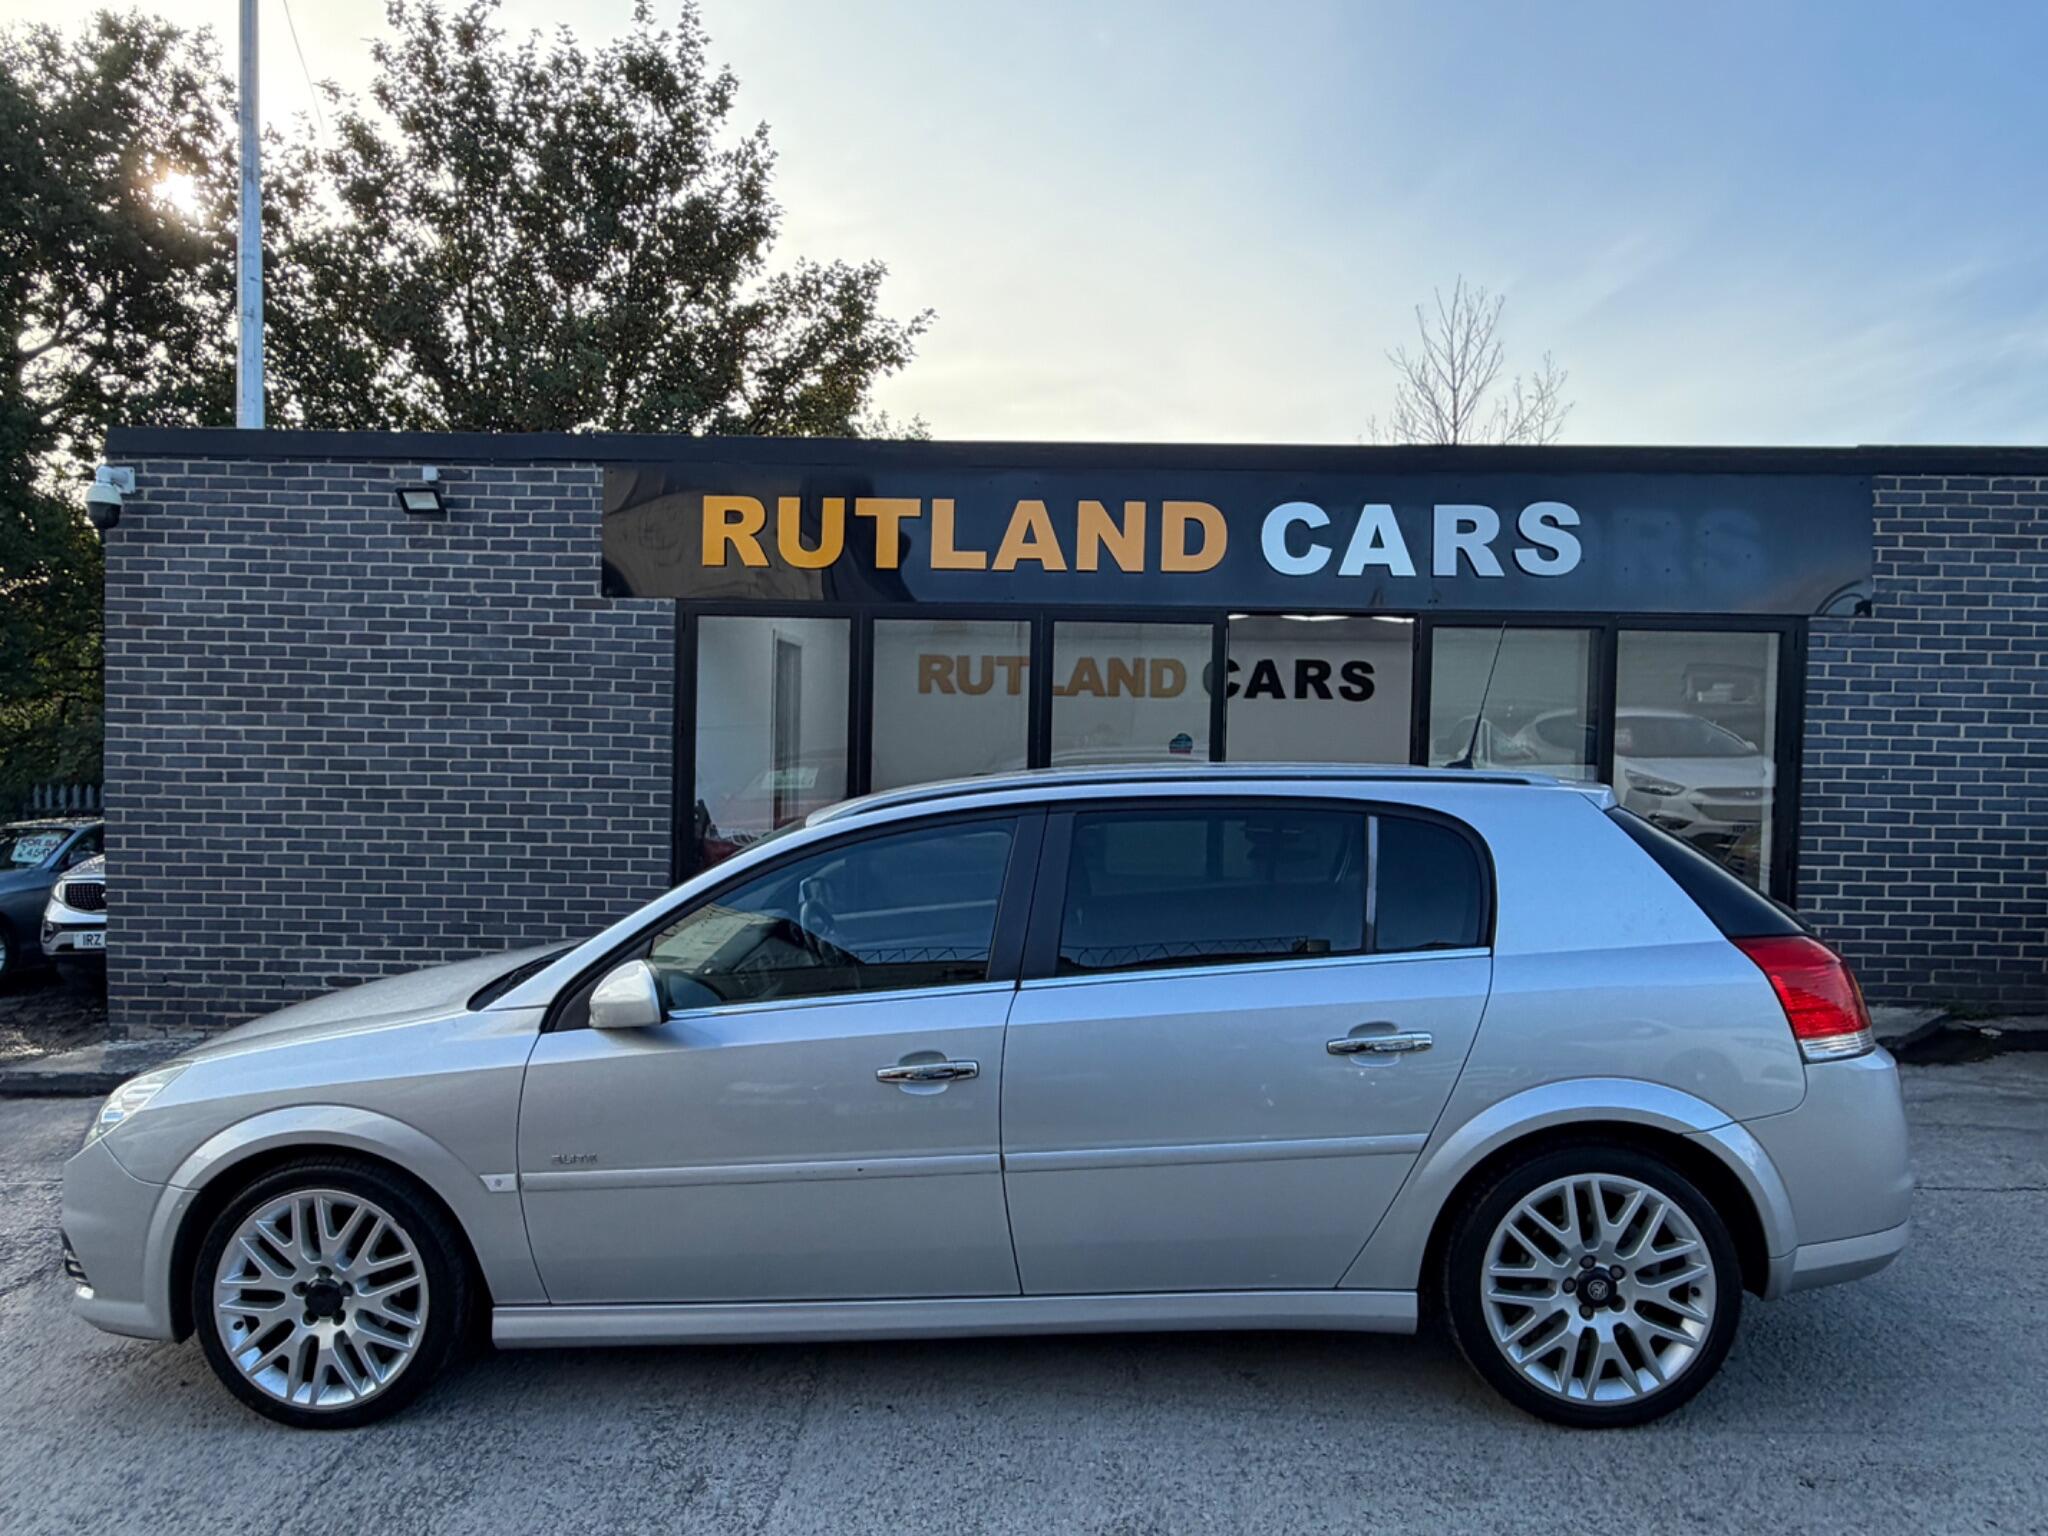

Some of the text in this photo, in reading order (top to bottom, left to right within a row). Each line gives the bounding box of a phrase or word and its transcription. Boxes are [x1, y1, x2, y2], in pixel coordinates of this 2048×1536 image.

[701, 495, 1583, 577] RUTLAND CARS
[1202, 658, 1376, 702] CARS
[83, 933, 102, 946] IRZ
